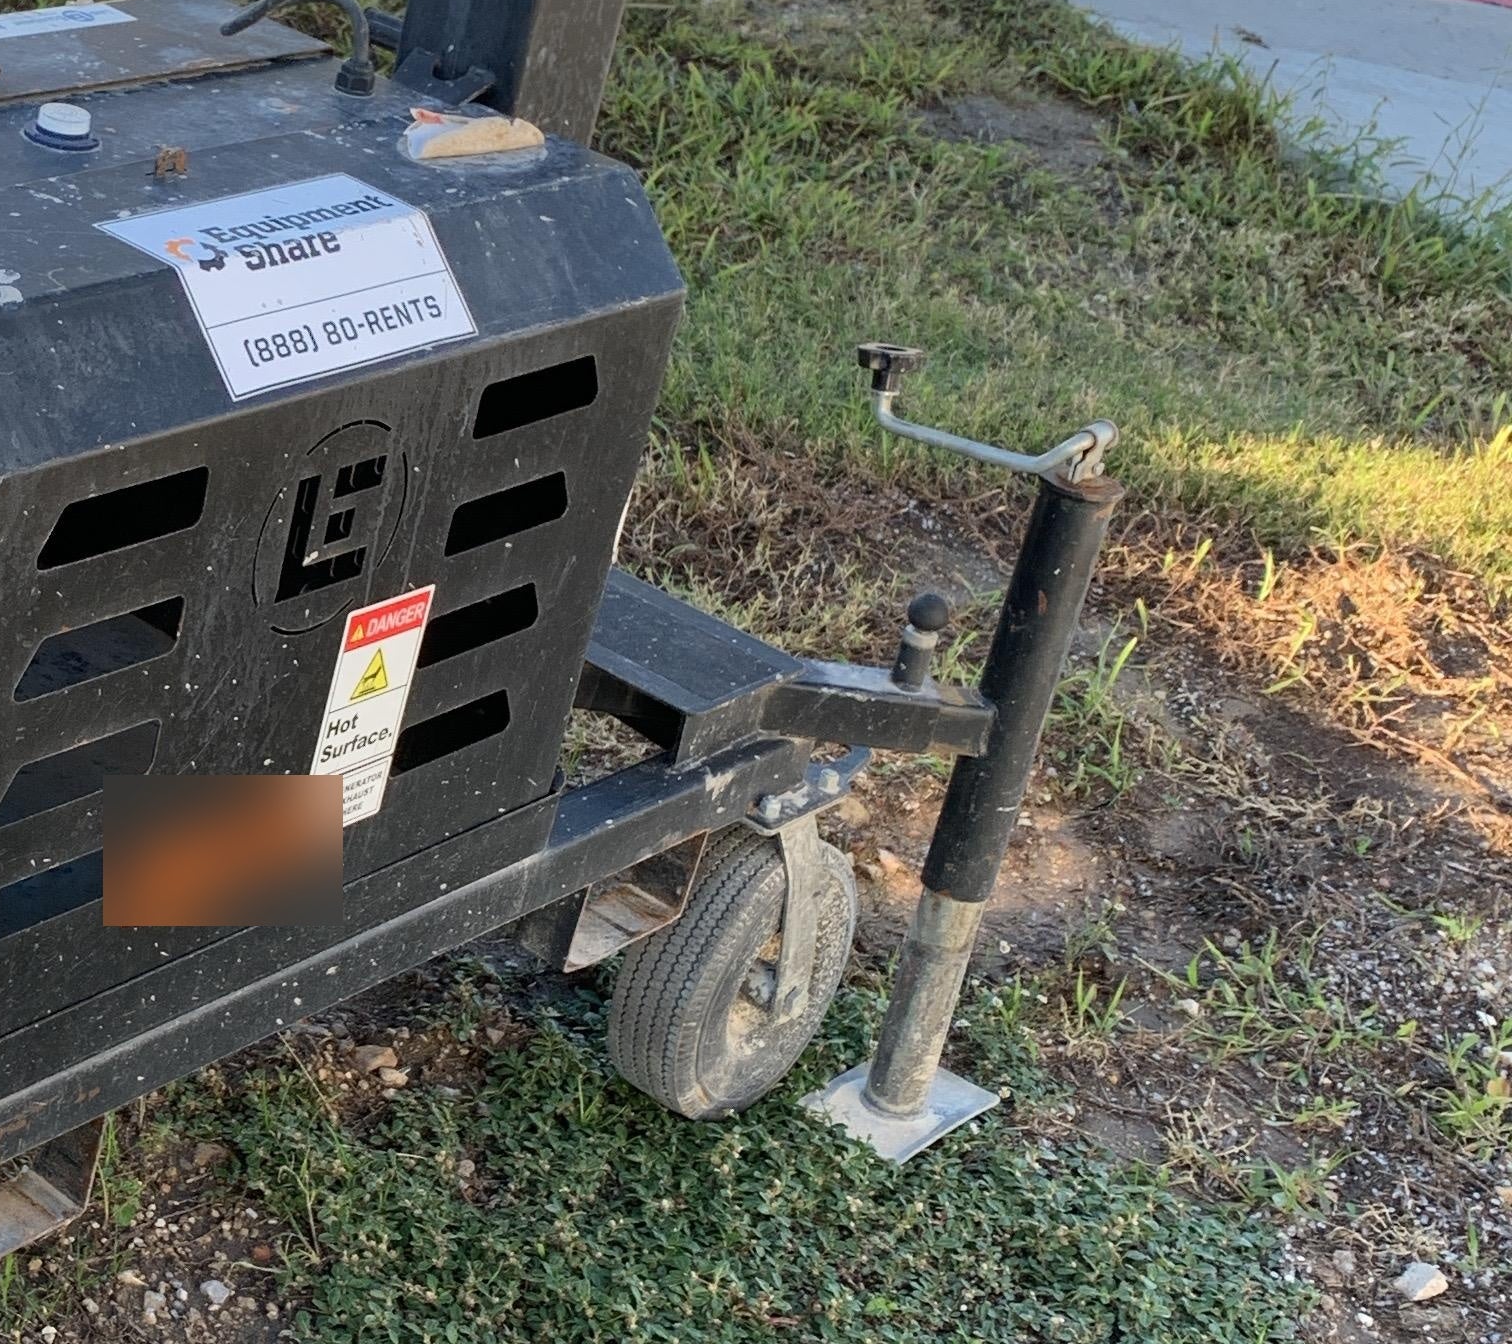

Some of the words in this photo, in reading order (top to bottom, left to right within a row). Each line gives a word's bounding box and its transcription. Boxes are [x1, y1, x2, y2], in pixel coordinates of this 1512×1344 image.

[197, 194, 393, 244] Equipment
[234, 229, 341, 271] Share
[243, 324, 319, 367] (888)
[322, 295, 442, 346] 80-RENTS
[365, 600, 426, 638] DANGER
[326, 712, 360, 739] Hot
[320, 727, 392, 764] Surface.
[344, 770, 383, 792] NERATOR
